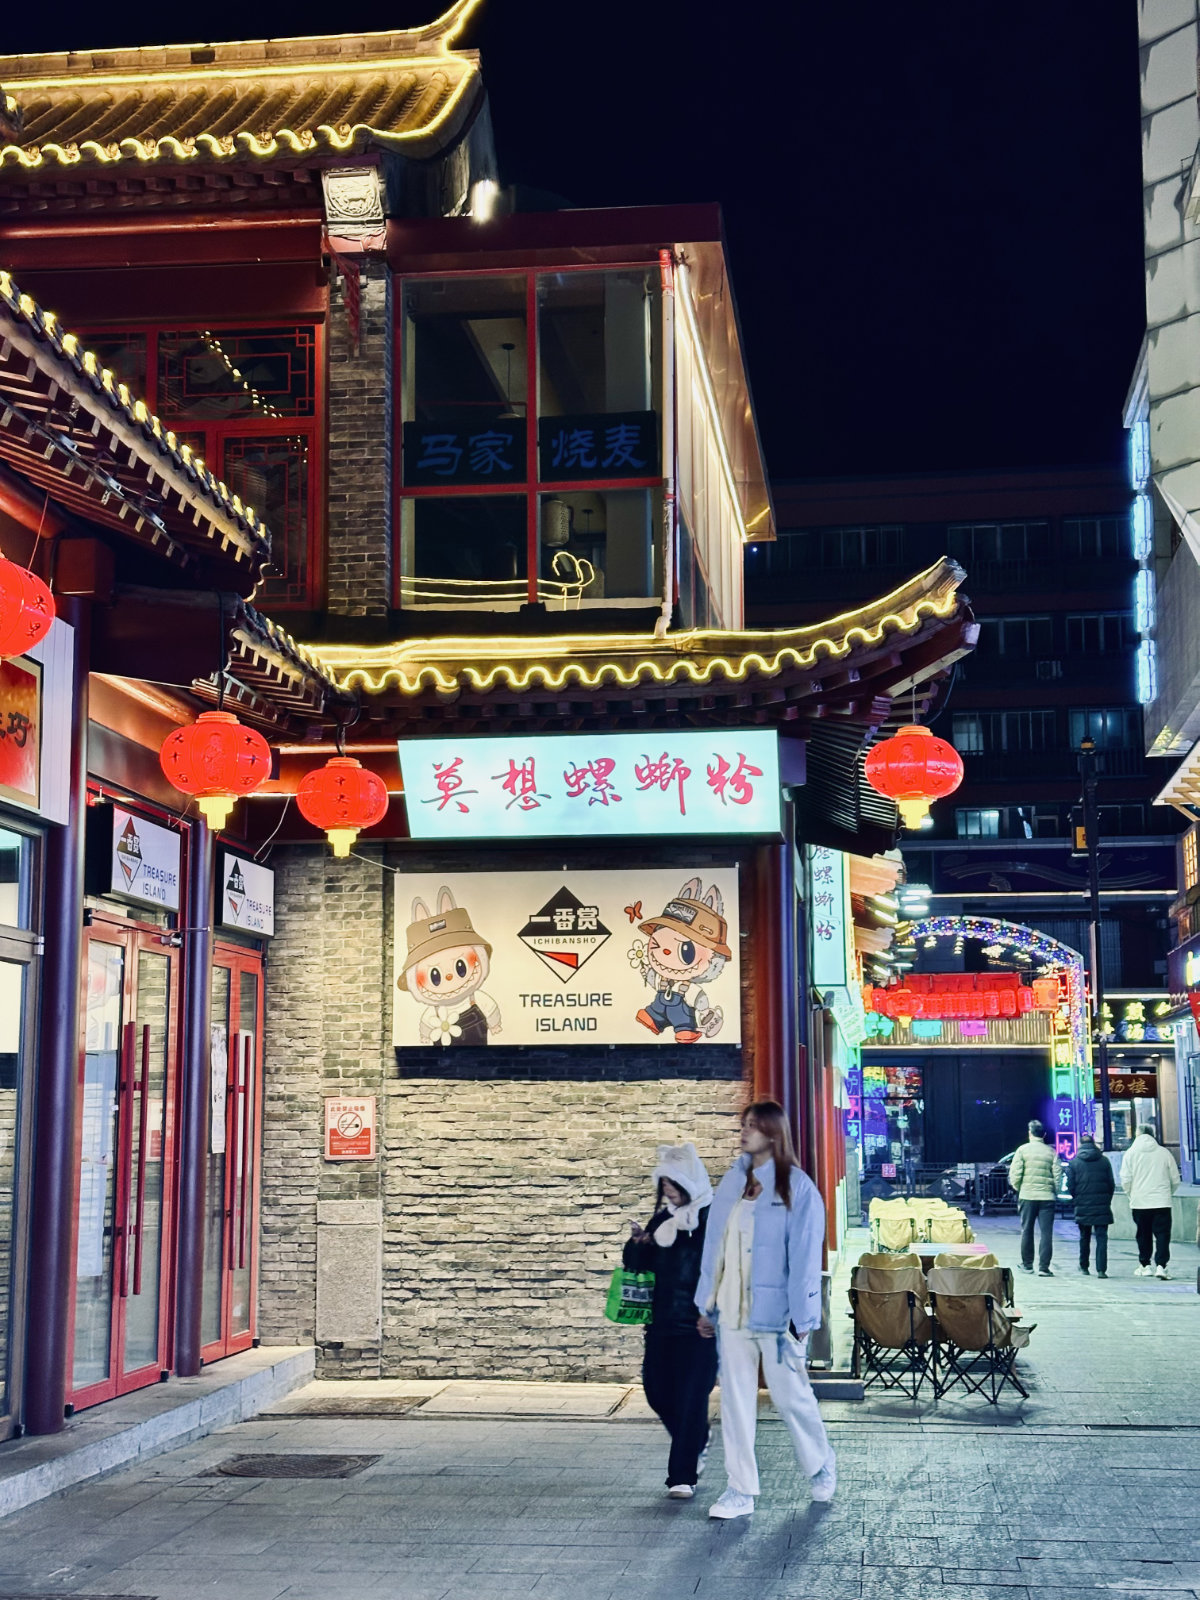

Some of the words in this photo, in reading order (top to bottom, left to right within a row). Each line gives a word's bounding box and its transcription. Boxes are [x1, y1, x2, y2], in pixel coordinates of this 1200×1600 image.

[143, 864, 176, 886] TREASURE
[143, 882, 166, 900] ISLAND
[529, 907, 599, 930] 一番赏
[533, 937, 597, 945] ICHIBANSHO
[519, 992, 612, 1008] TREASURE
[535, 1017, 598, 1032] ISLAND
